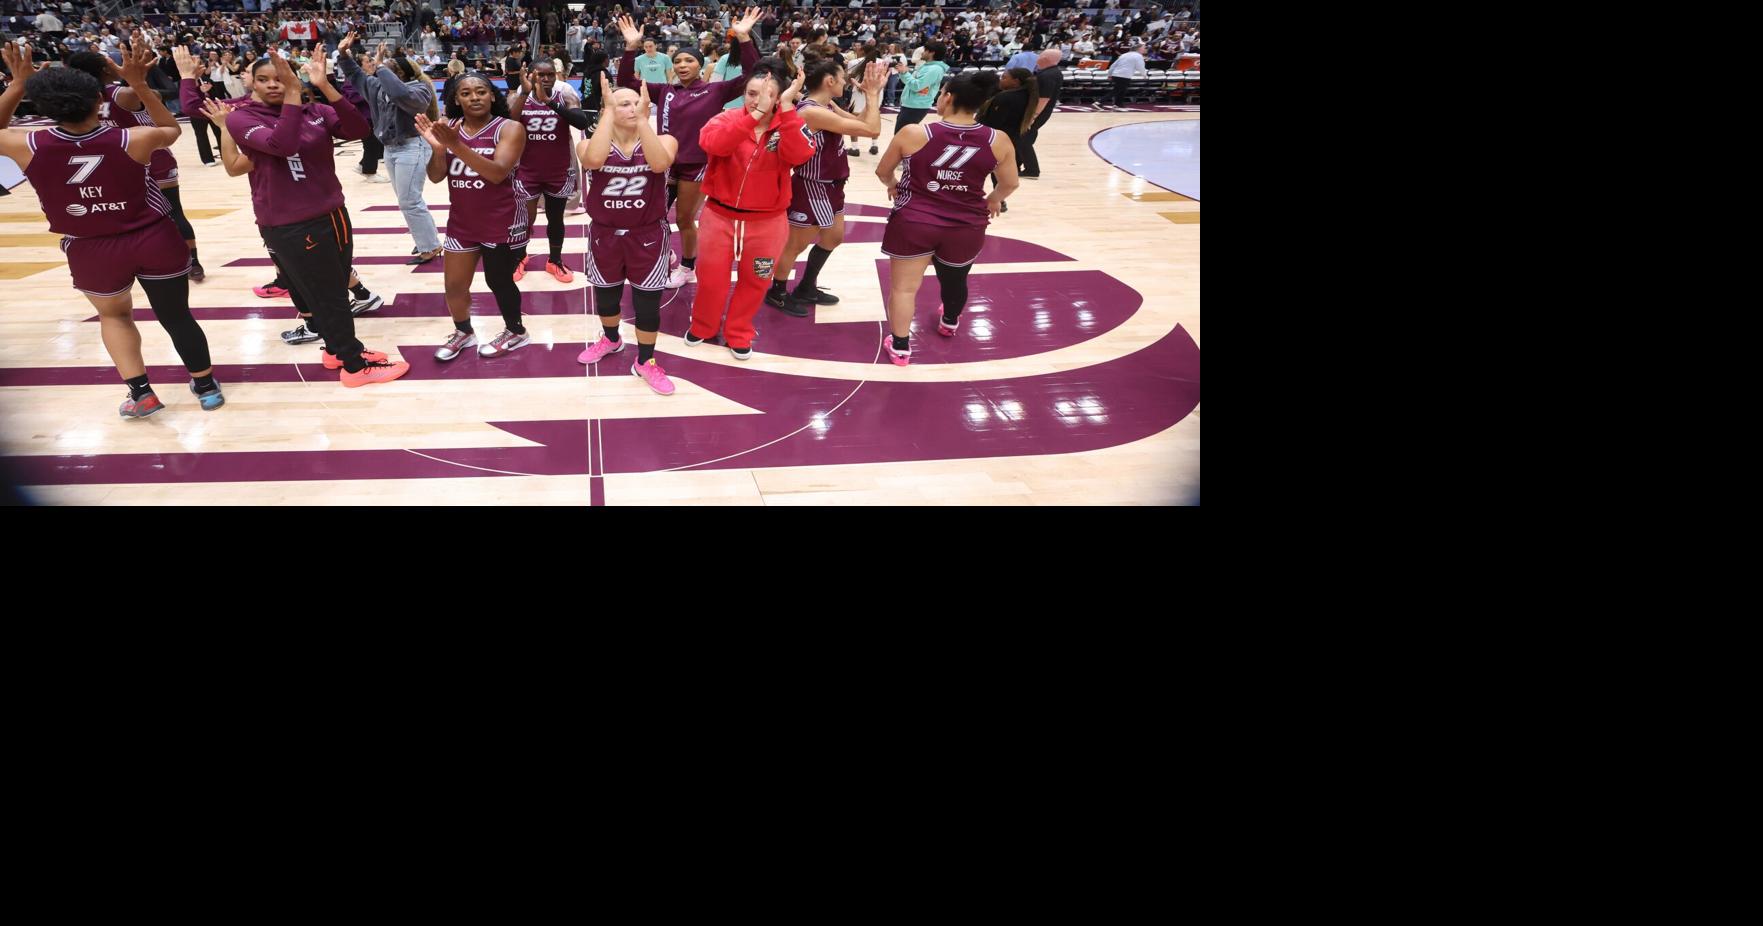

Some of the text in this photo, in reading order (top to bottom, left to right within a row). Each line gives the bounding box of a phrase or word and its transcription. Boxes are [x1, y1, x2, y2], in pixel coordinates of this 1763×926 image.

[662, 92, 675, 133] TEMPO
[527, 117, 558, 132] 33
[528, 133, 548, 141] CIBC
[930, 144, 981, 169] 11
[66, 154, 105, 185] 7
[936, 169, 963, 181] NURSE
[451, 180, 473, 189] CIBC
[601, 175, 648, 197] 22
[79, 186, 104, 199] KEY
[91, 201, 127, 213] AT&T
[603, 199, 633, 209] CIBC
